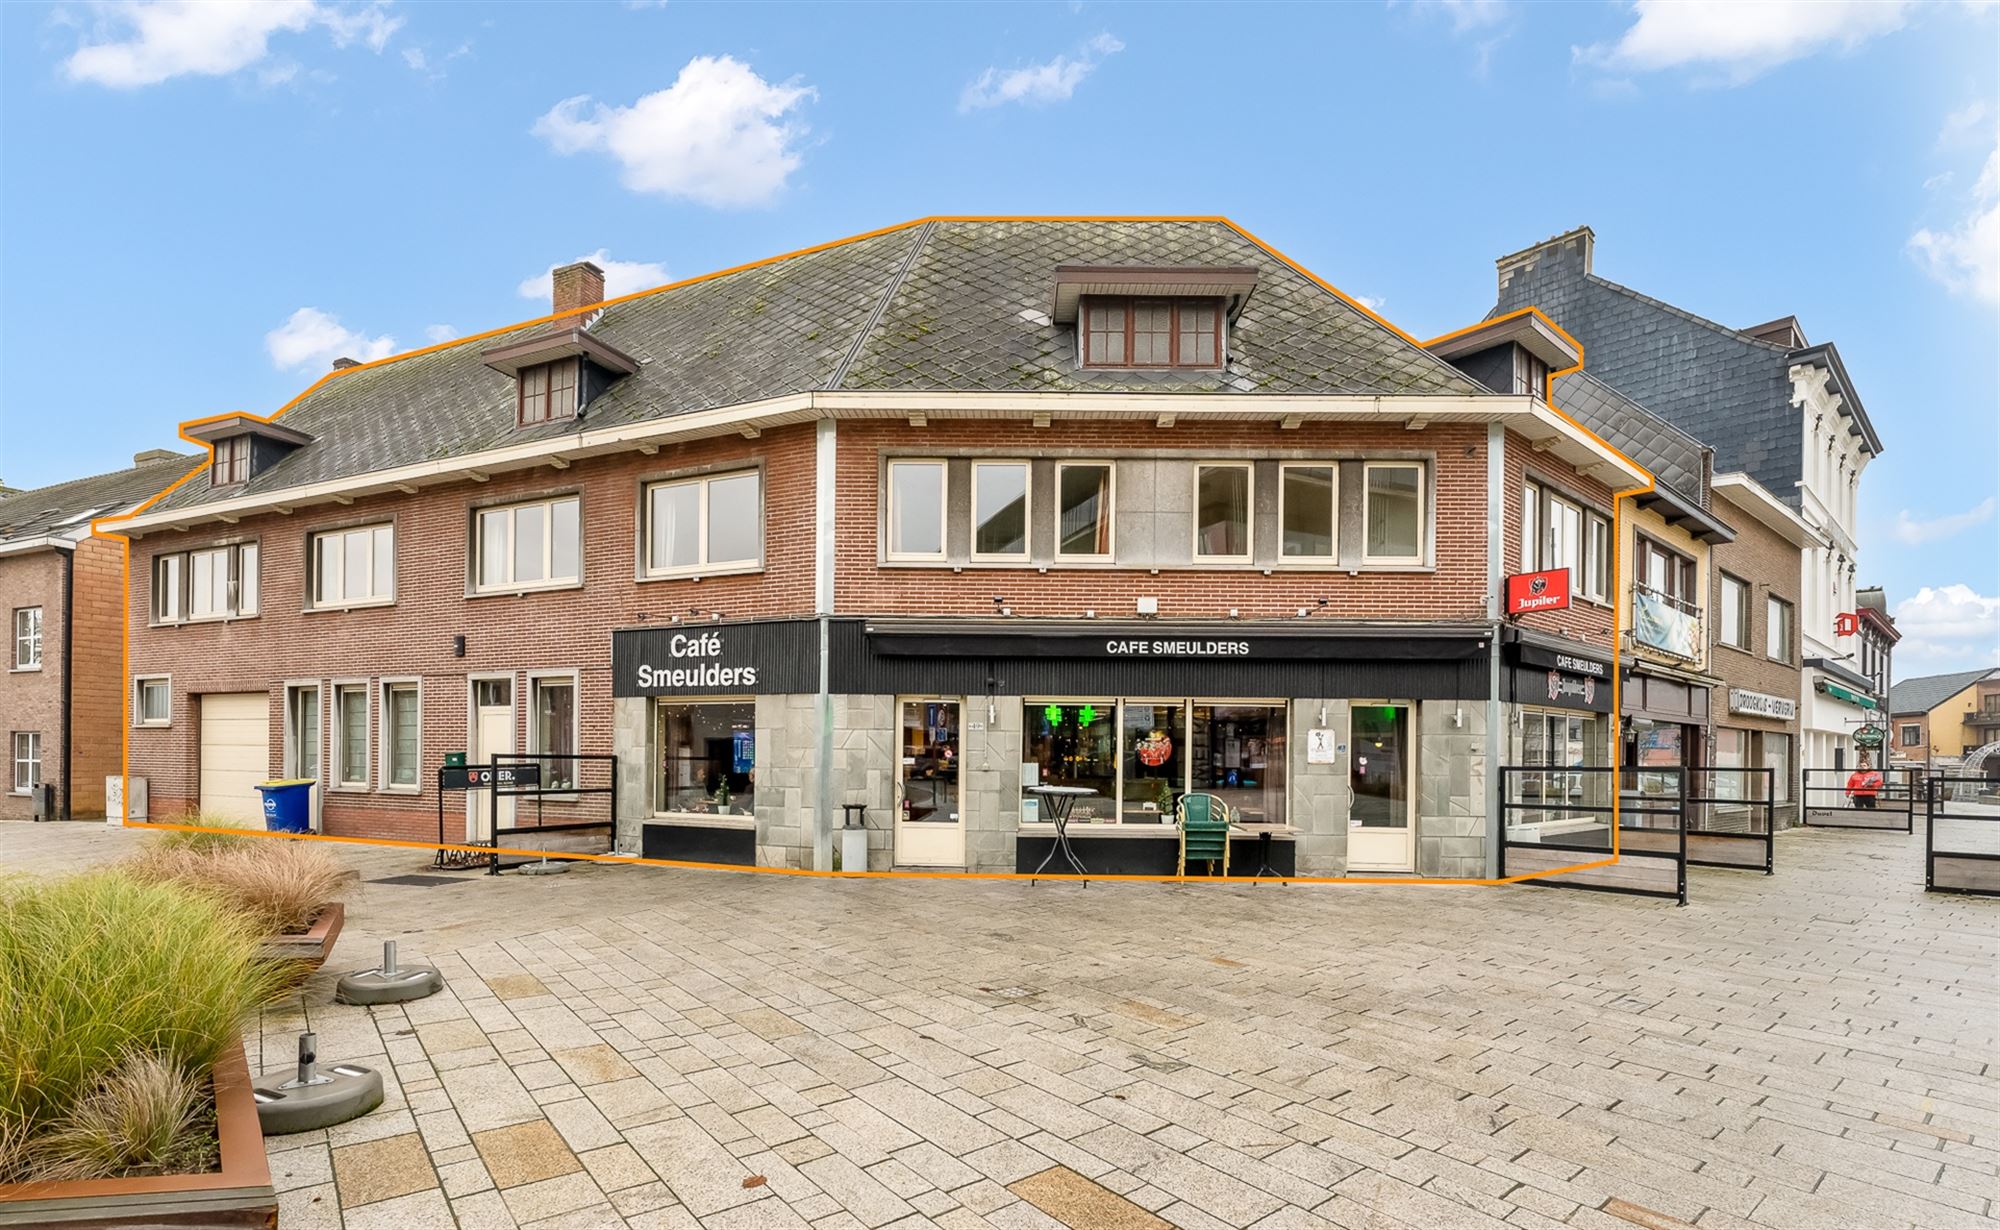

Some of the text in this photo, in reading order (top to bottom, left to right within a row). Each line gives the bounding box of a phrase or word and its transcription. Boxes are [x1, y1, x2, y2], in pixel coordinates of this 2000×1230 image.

[1517, 595, 1561, 609] Jupiler
[670, 632, 721, 658] Café
[1106, 640, 1250, 655] CAFE SMEULDERS
[1556, 654, 1604, 675] CAFE SMEULDERS
[637, 664, 757, 688] Smeulders
[480, 770, 516, 782] OER.
